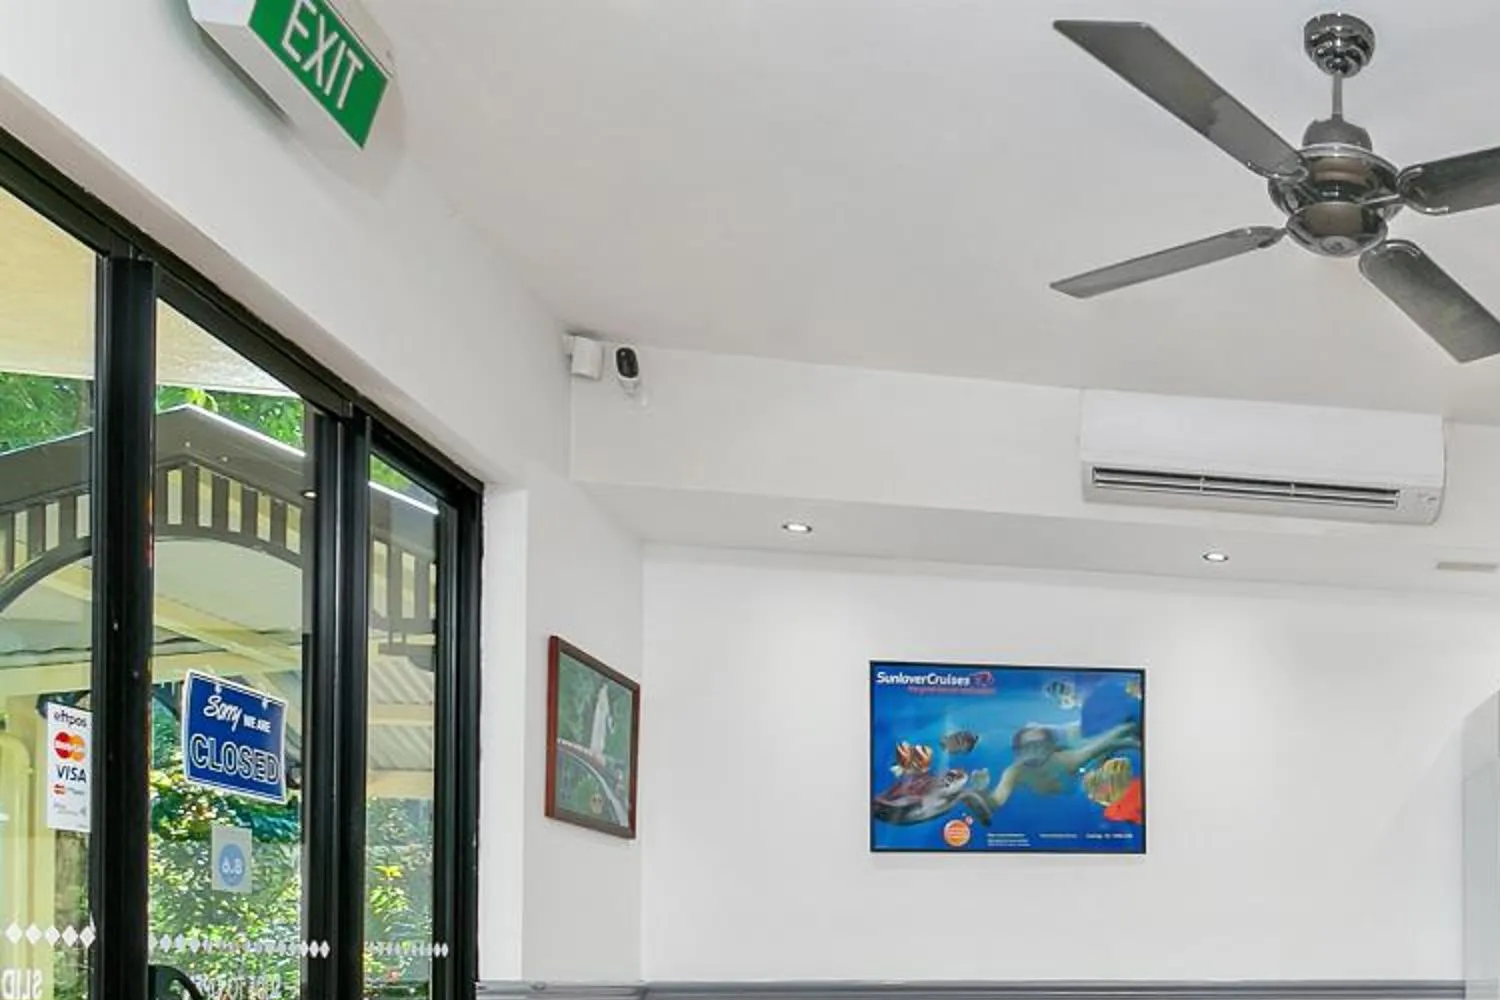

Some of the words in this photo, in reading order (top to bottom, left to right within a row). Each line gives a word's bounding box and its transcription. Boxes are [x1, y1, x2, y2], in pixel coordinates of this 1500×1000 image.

[281, 0, 364, 110] EXIT
[876, 671, 971, 686] SunloverCruises
[203, 695, 242, 732] Sorry
[56, 765, 88, 785] VISA
[190, 733, 280, 785] CLOSED
